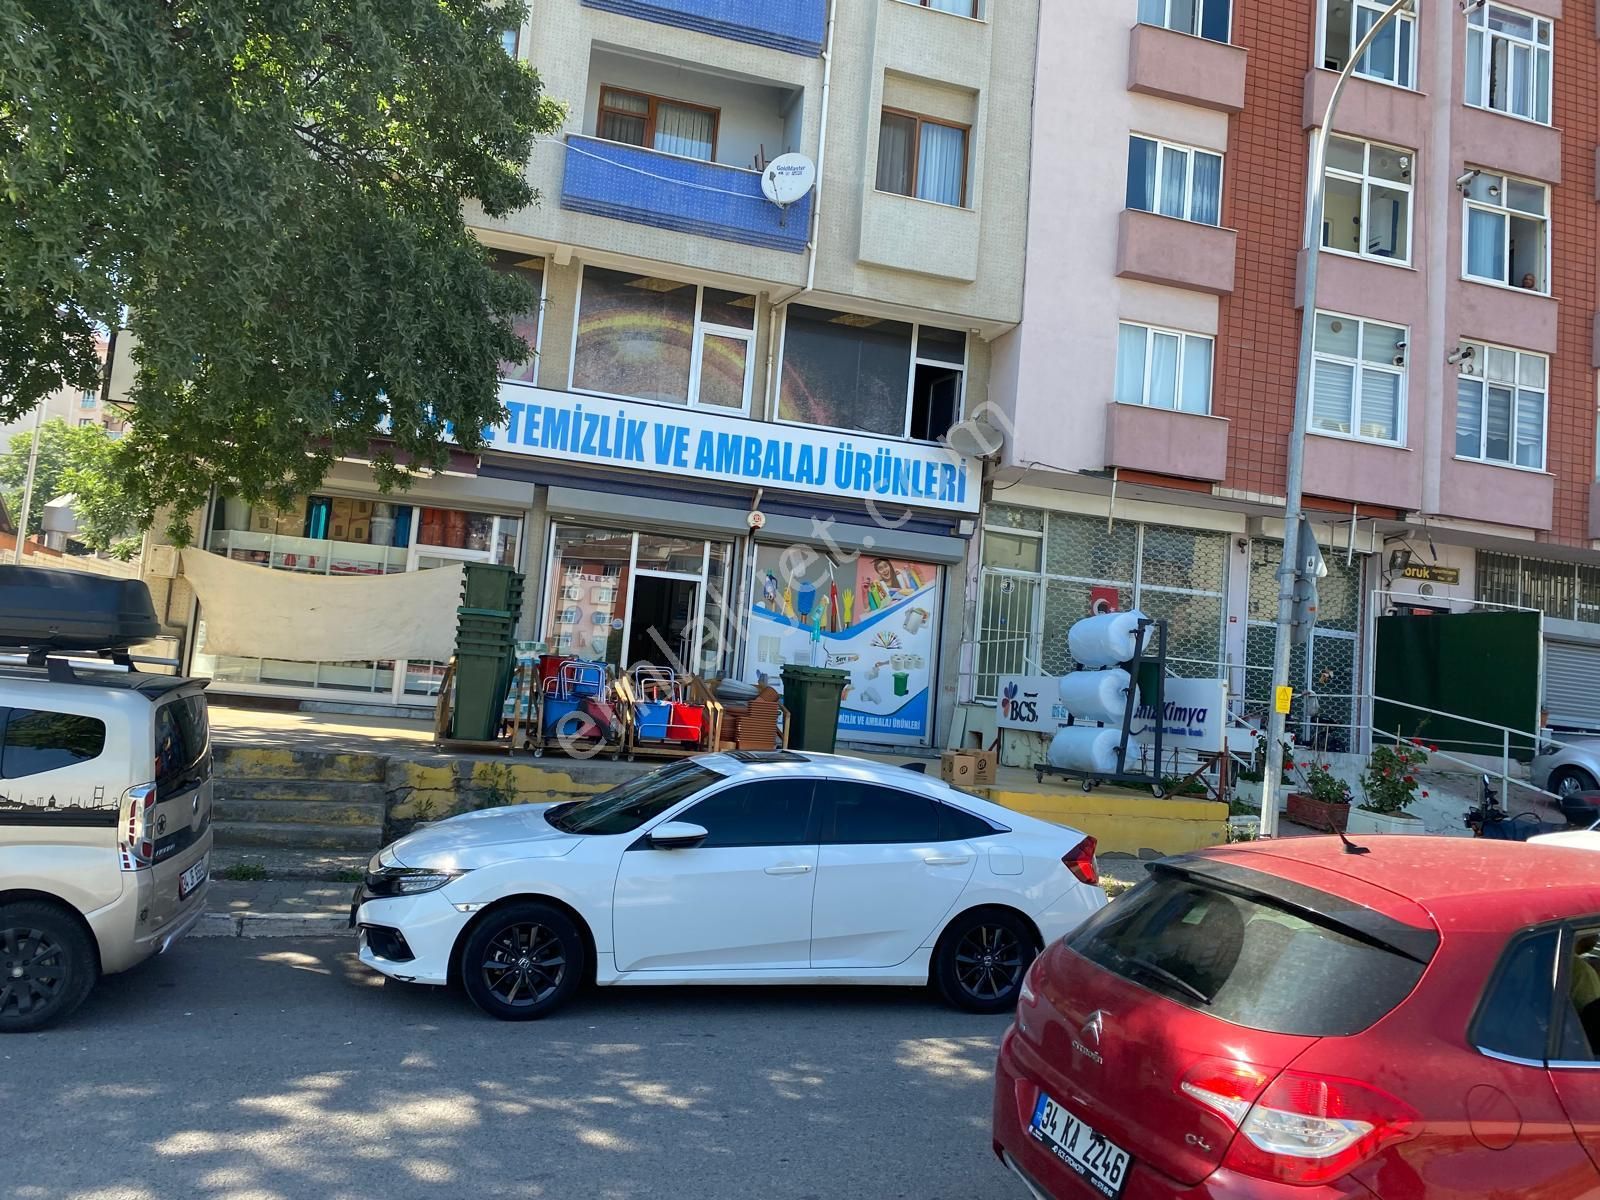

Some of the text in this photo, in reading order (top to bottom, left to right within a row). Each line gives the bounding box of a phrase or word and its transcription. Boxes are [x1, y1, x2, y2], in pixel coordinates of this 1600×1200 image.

[505, 400, 647, 461] TEMİZLİK
[654, 424, 690, 469] VE
[694, 430, 829, 487] AMBALAJ
[834, 441, 967, 503] ÜRÜNLERİ
[857, 715, 865, 725] VE
[1041, 1101, 1125, 1184] 34 KA 2246
